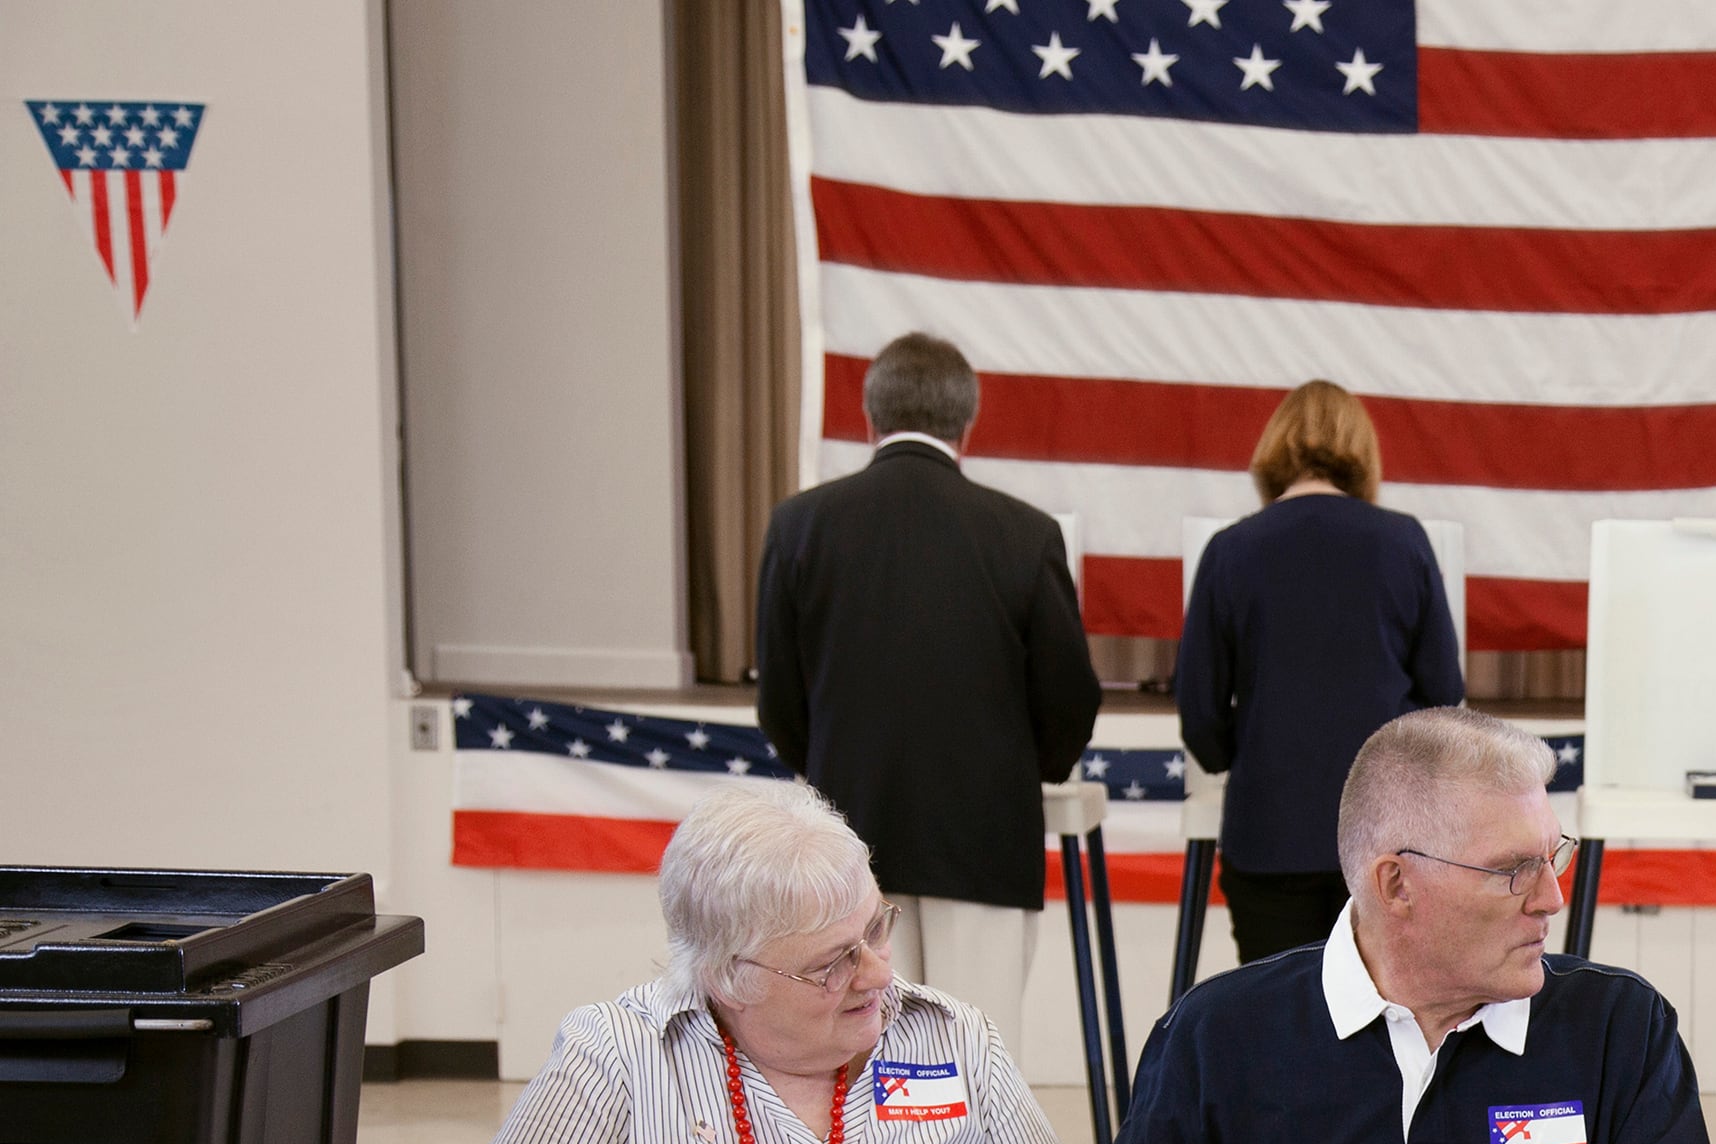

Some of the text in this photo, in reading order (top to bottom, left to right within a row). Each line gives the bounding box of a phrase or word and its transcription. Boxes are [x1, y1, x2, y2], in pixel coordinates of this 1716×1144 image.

[878, 1067, 950, 1077] ELECTION OFFICIAL
[910, 1107, 929, 1115] HELP
[930, 1107, 951, 1115] YOU?
[1495, 1107, 1576, 1119] ELECTION OFFICIAL
